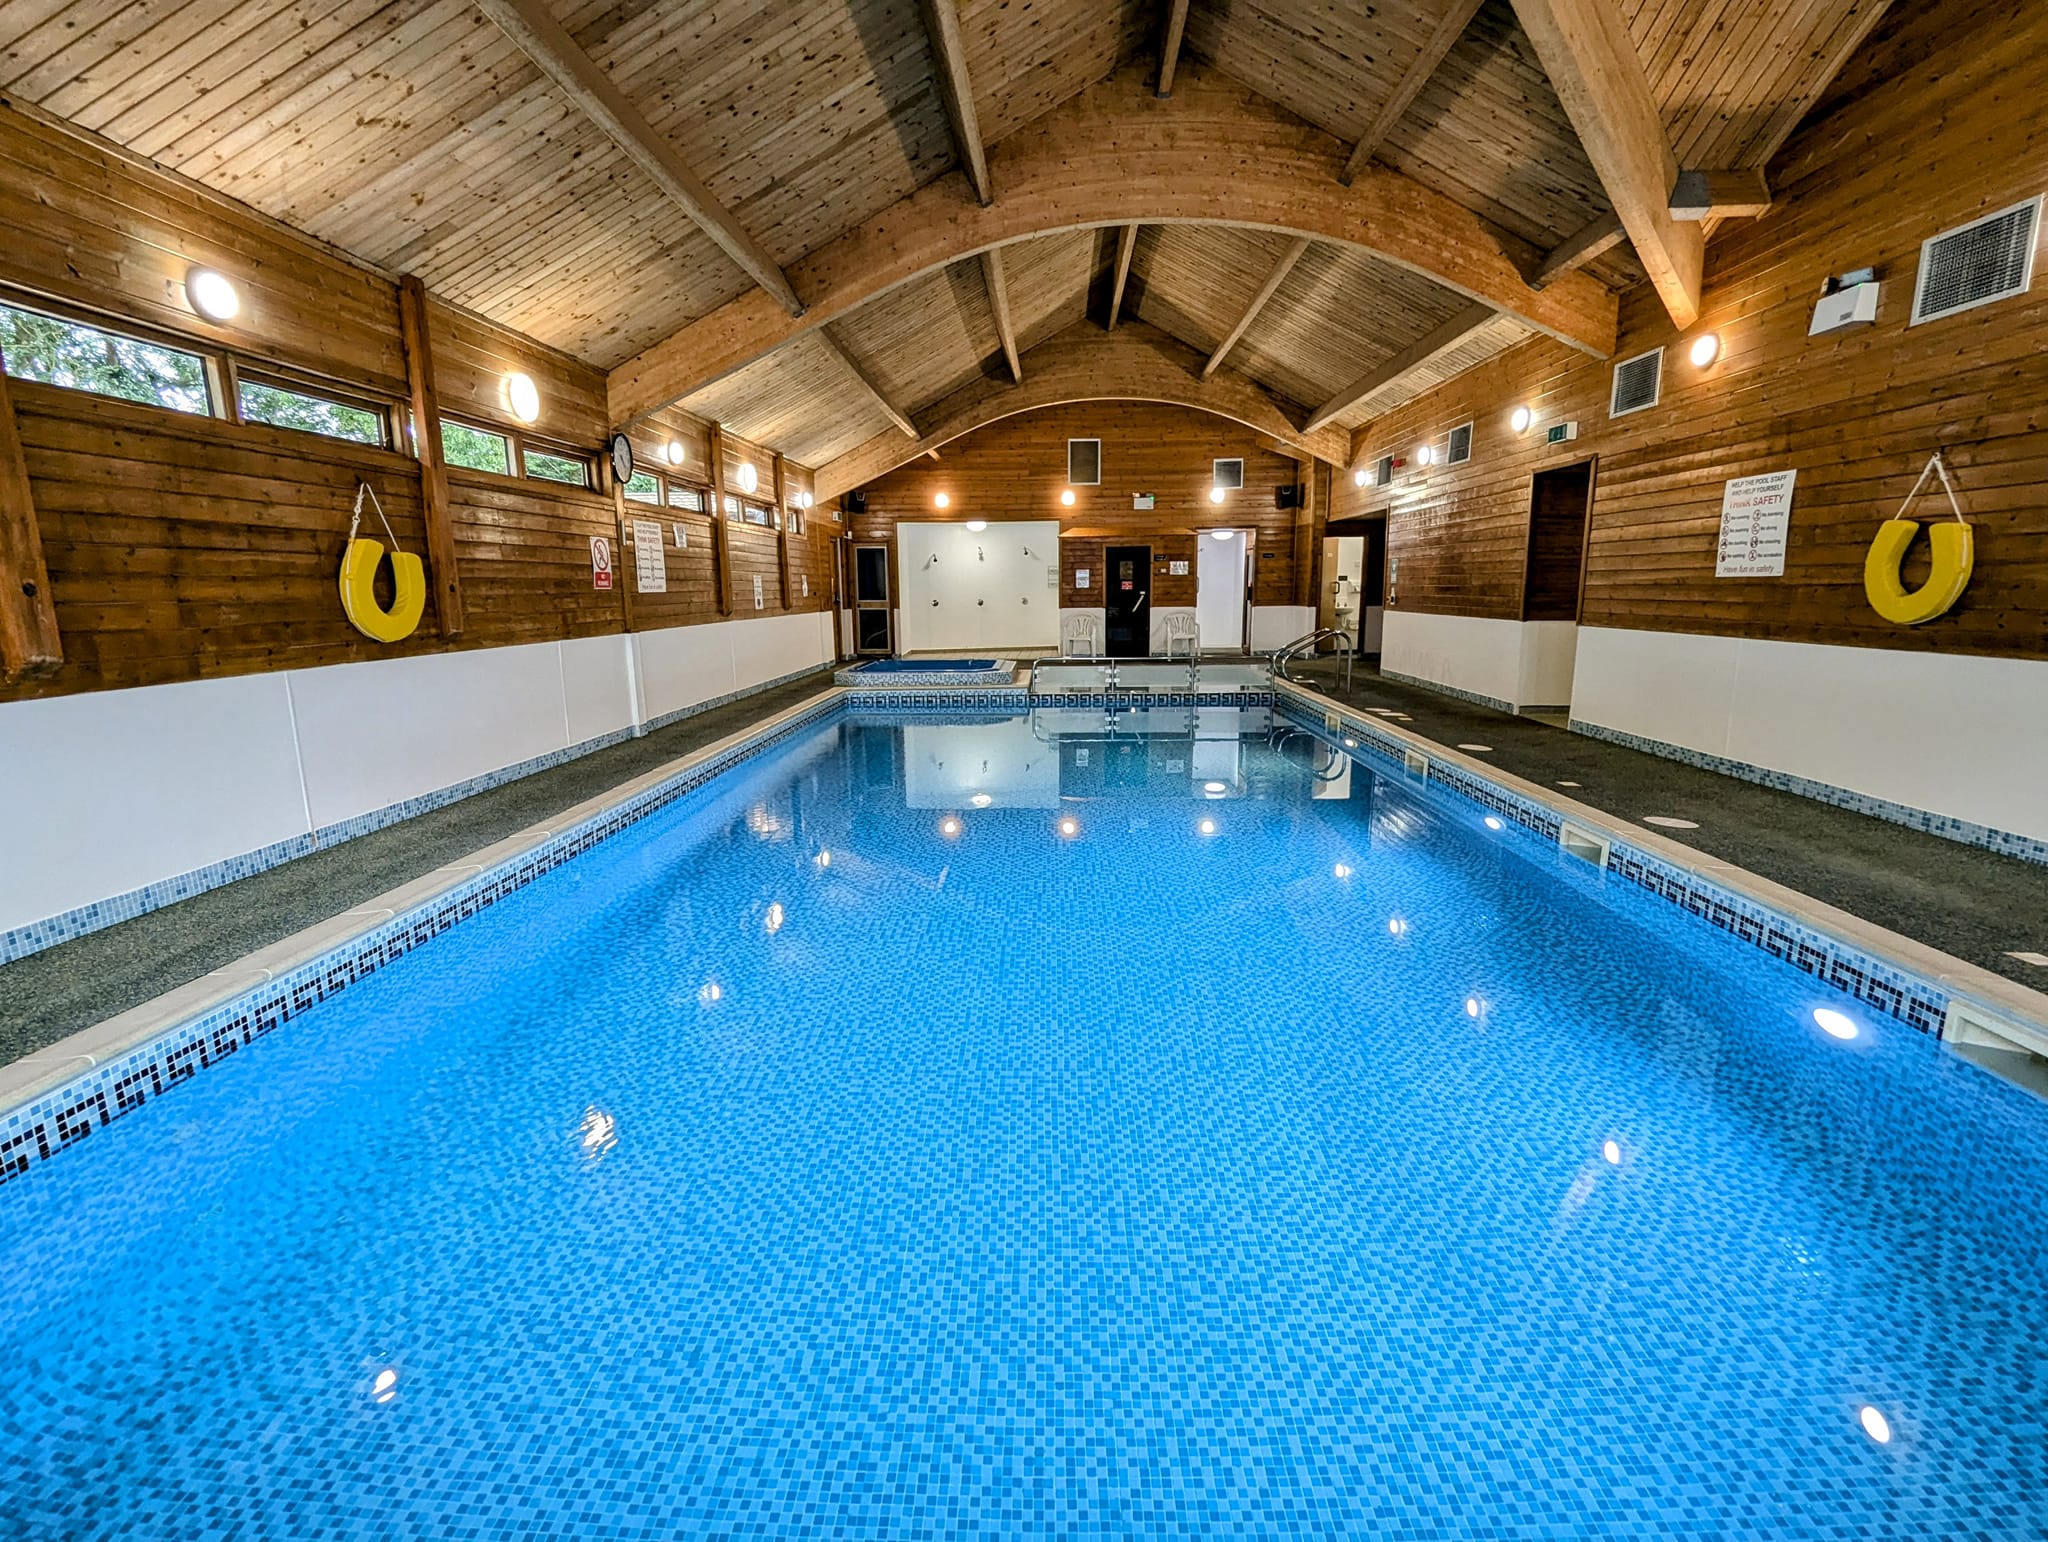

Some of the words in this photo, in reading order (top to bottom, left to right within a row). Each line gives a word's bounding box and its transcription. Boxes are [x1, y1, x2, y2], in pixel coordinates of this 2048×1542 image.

[1756, 478, 1769, 486] POOL
[1757, 484, 1784, 493] YOURSELF
[1753, 494, 1784, 506] SAFETY
[1756, 564, 1774, 574] safety
